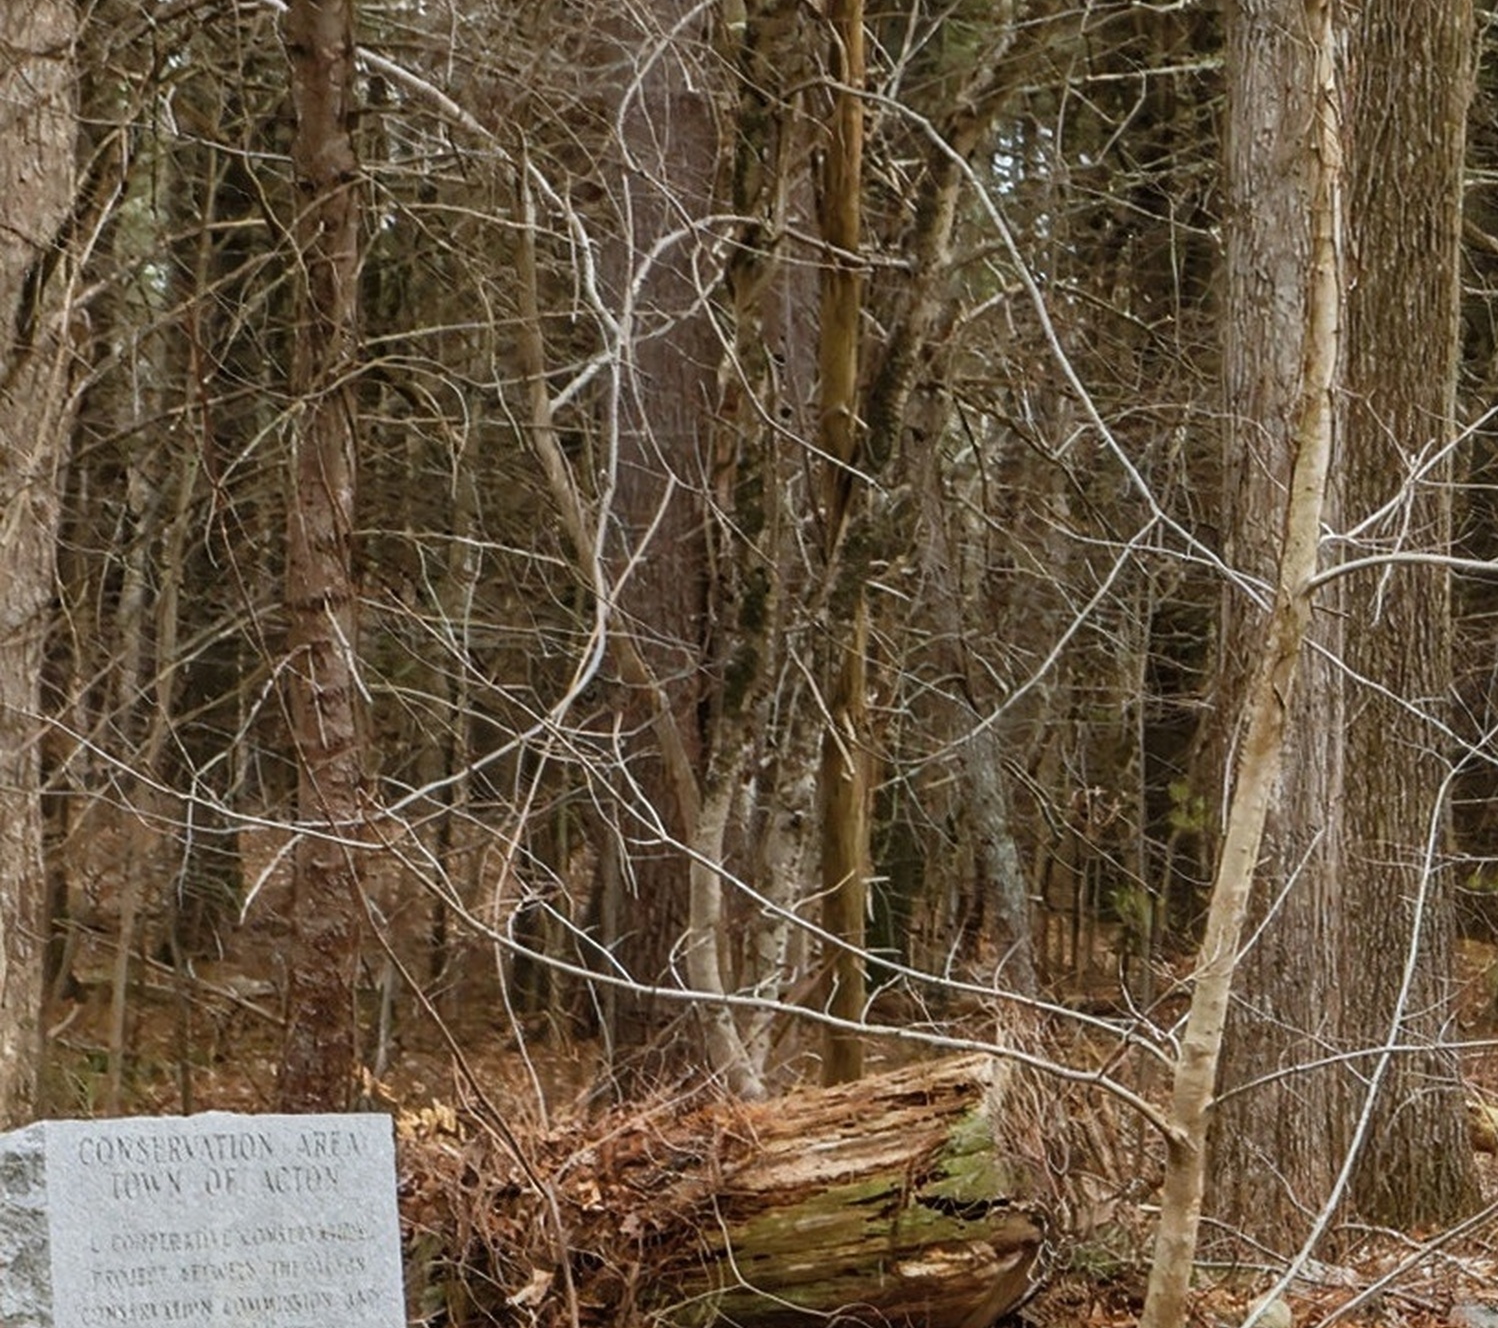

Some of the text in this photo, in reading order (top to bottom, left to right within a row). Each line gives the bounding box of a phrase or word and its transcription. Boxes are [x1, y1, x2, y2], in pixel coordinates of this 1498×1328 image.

[79, 1130, 365, 1166] CONSERVATION AREA
[111, 1165, 340, 1199] TOWN OF ACTON
